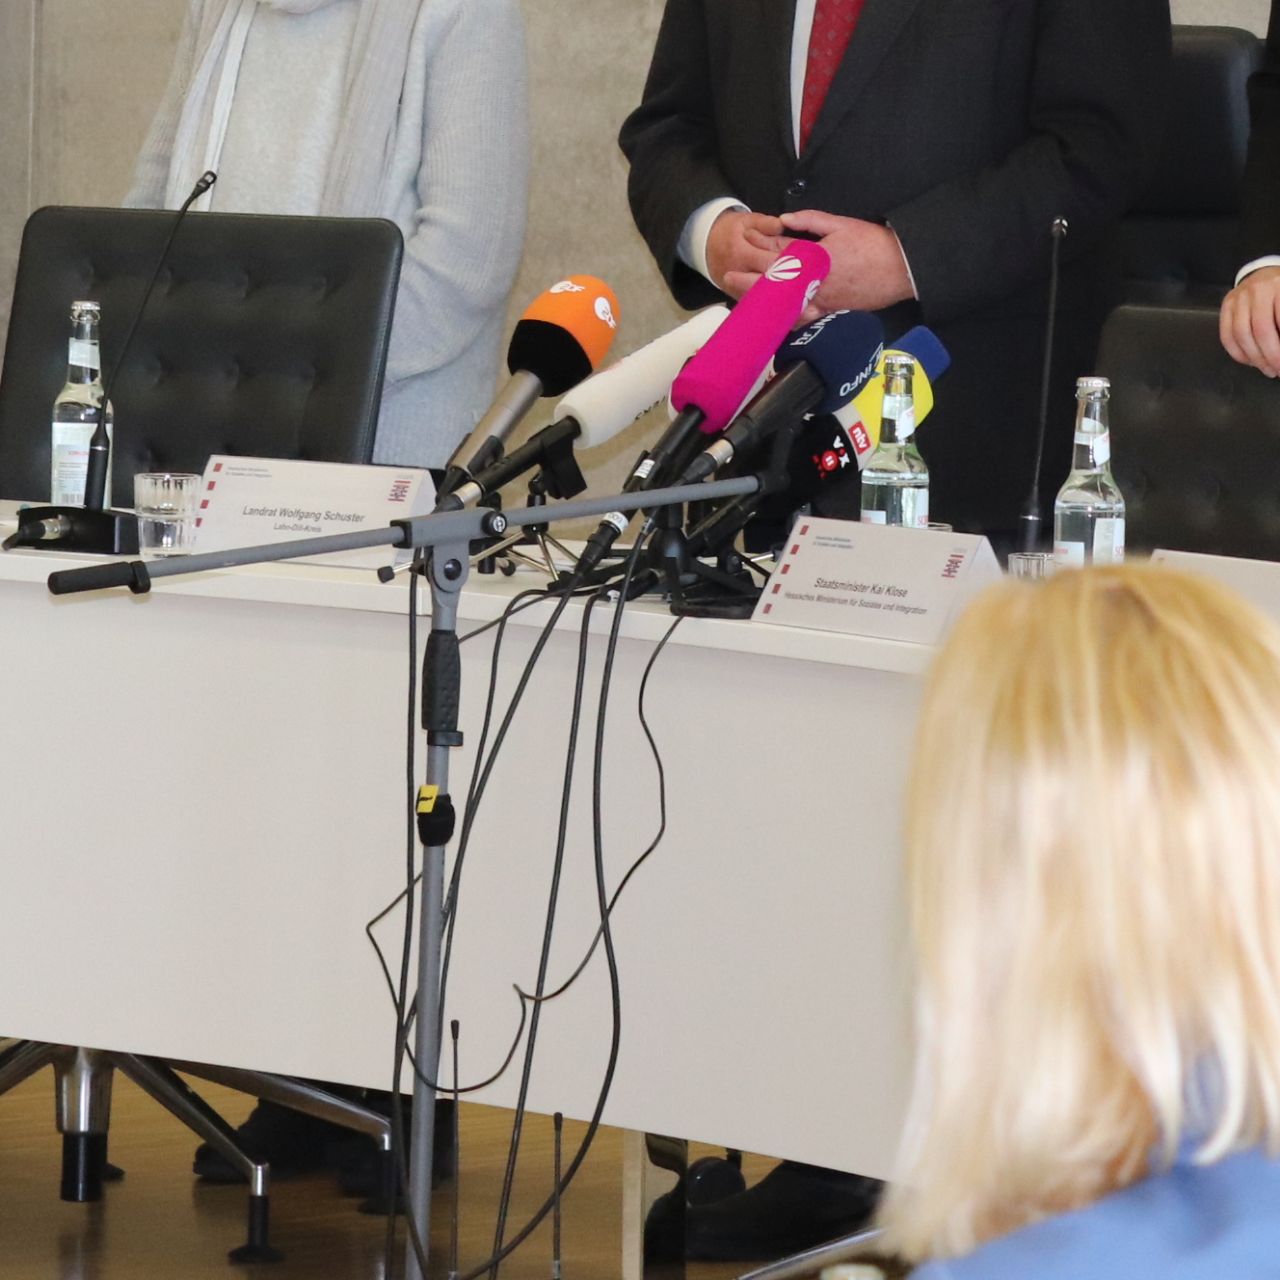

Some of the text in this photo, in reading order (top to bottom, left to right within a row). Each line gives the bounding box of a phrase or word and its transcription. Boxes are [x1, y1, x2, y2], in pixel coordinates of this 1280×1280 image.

[852, 426, 868, 449] ntv
[243, 506, 366, 523] Landrat Wolfgang Schuster
[814, 577, 908, 598] Staatsminister Kai Klose
